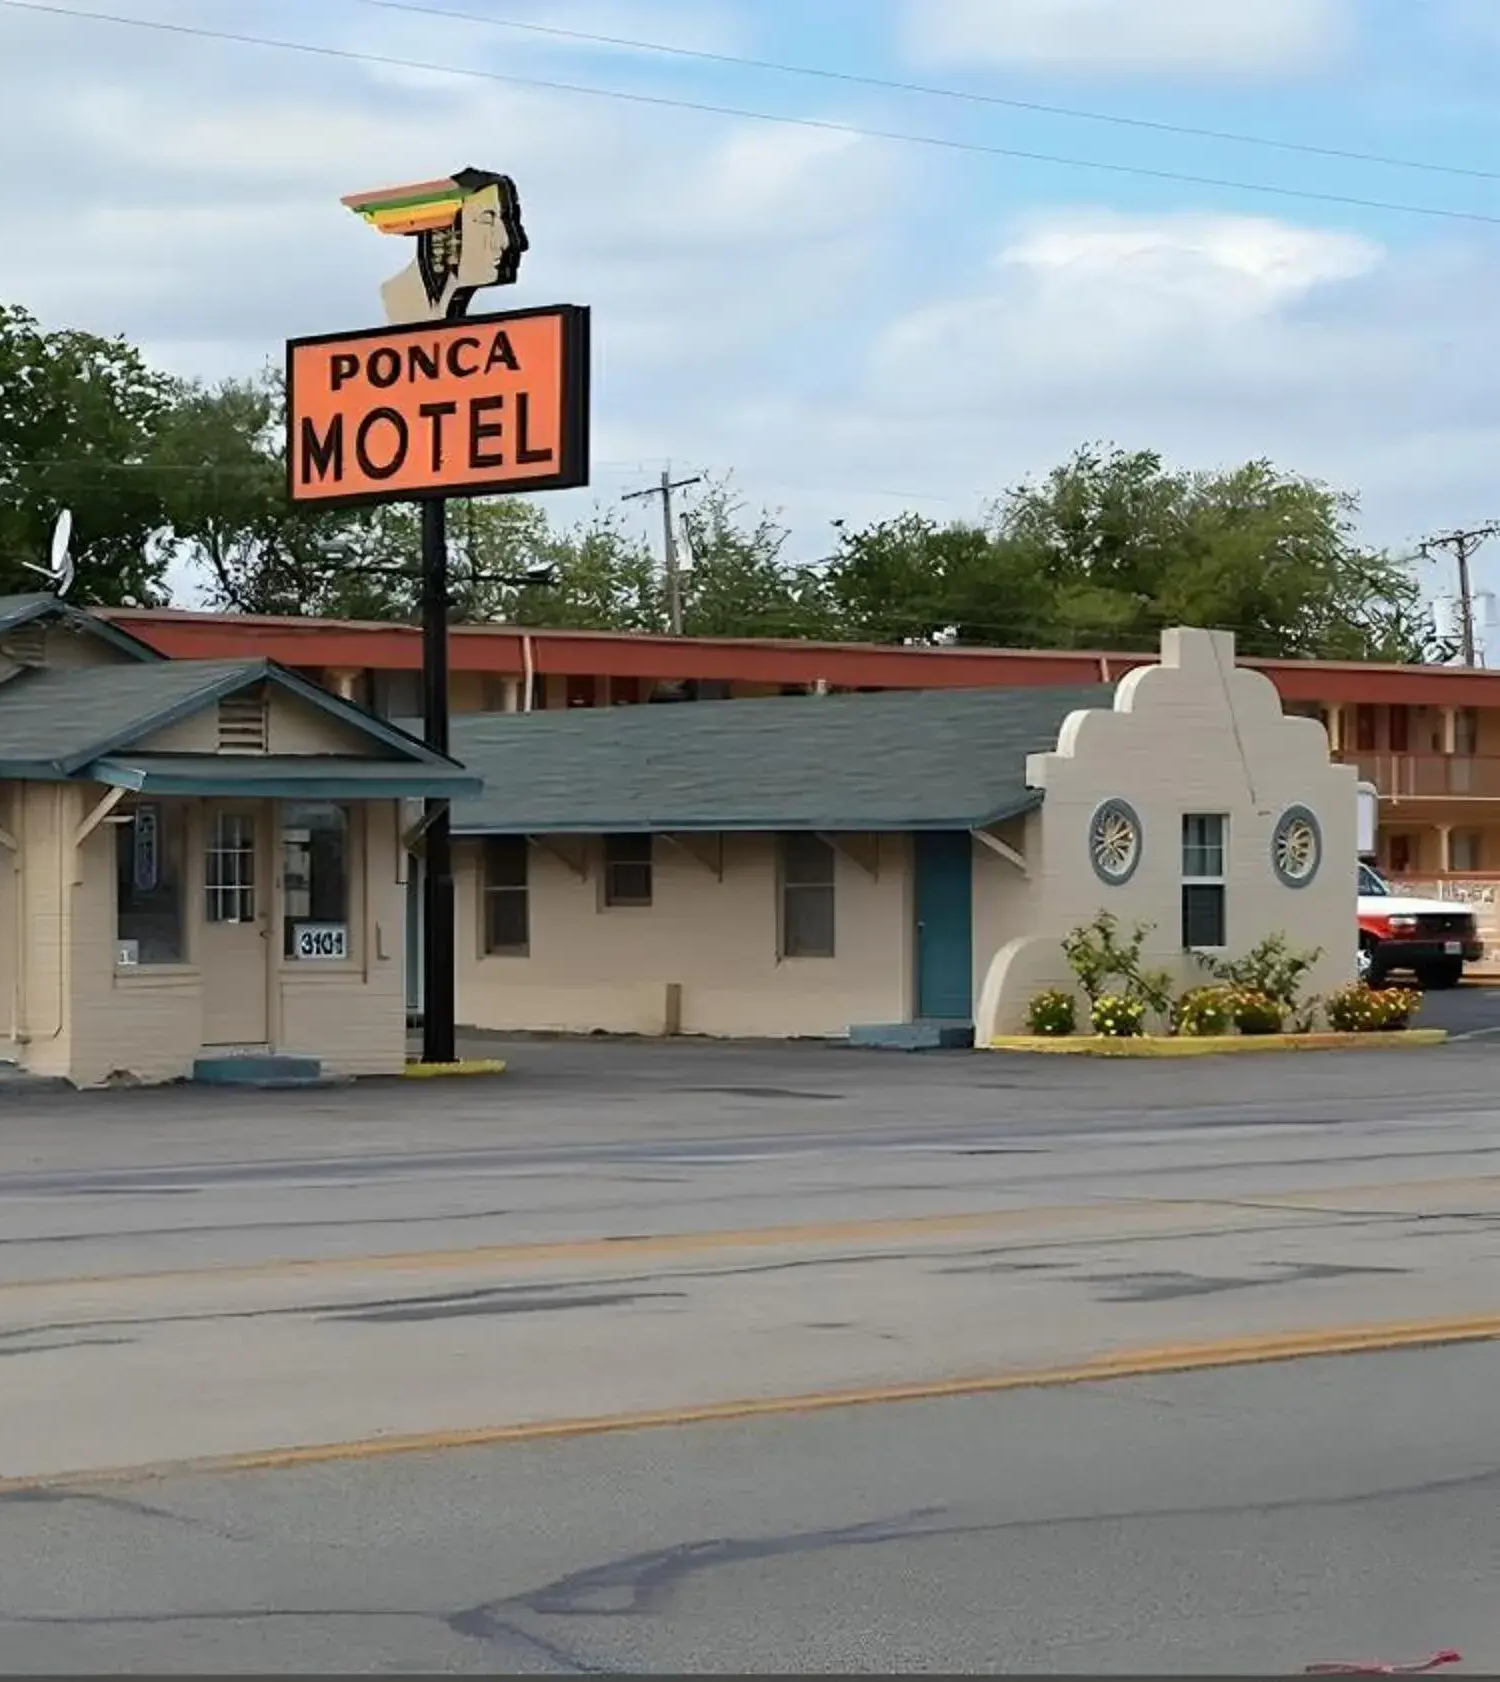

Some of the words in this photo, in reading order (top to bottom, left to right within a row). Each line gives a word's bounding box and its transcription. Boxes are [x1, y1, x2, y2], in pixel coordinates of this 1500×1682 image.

[329, 330, 521, 391] PONCA
[301, 392, 553, 485] MOTEL
[301, 932, 343, 955] 3101
